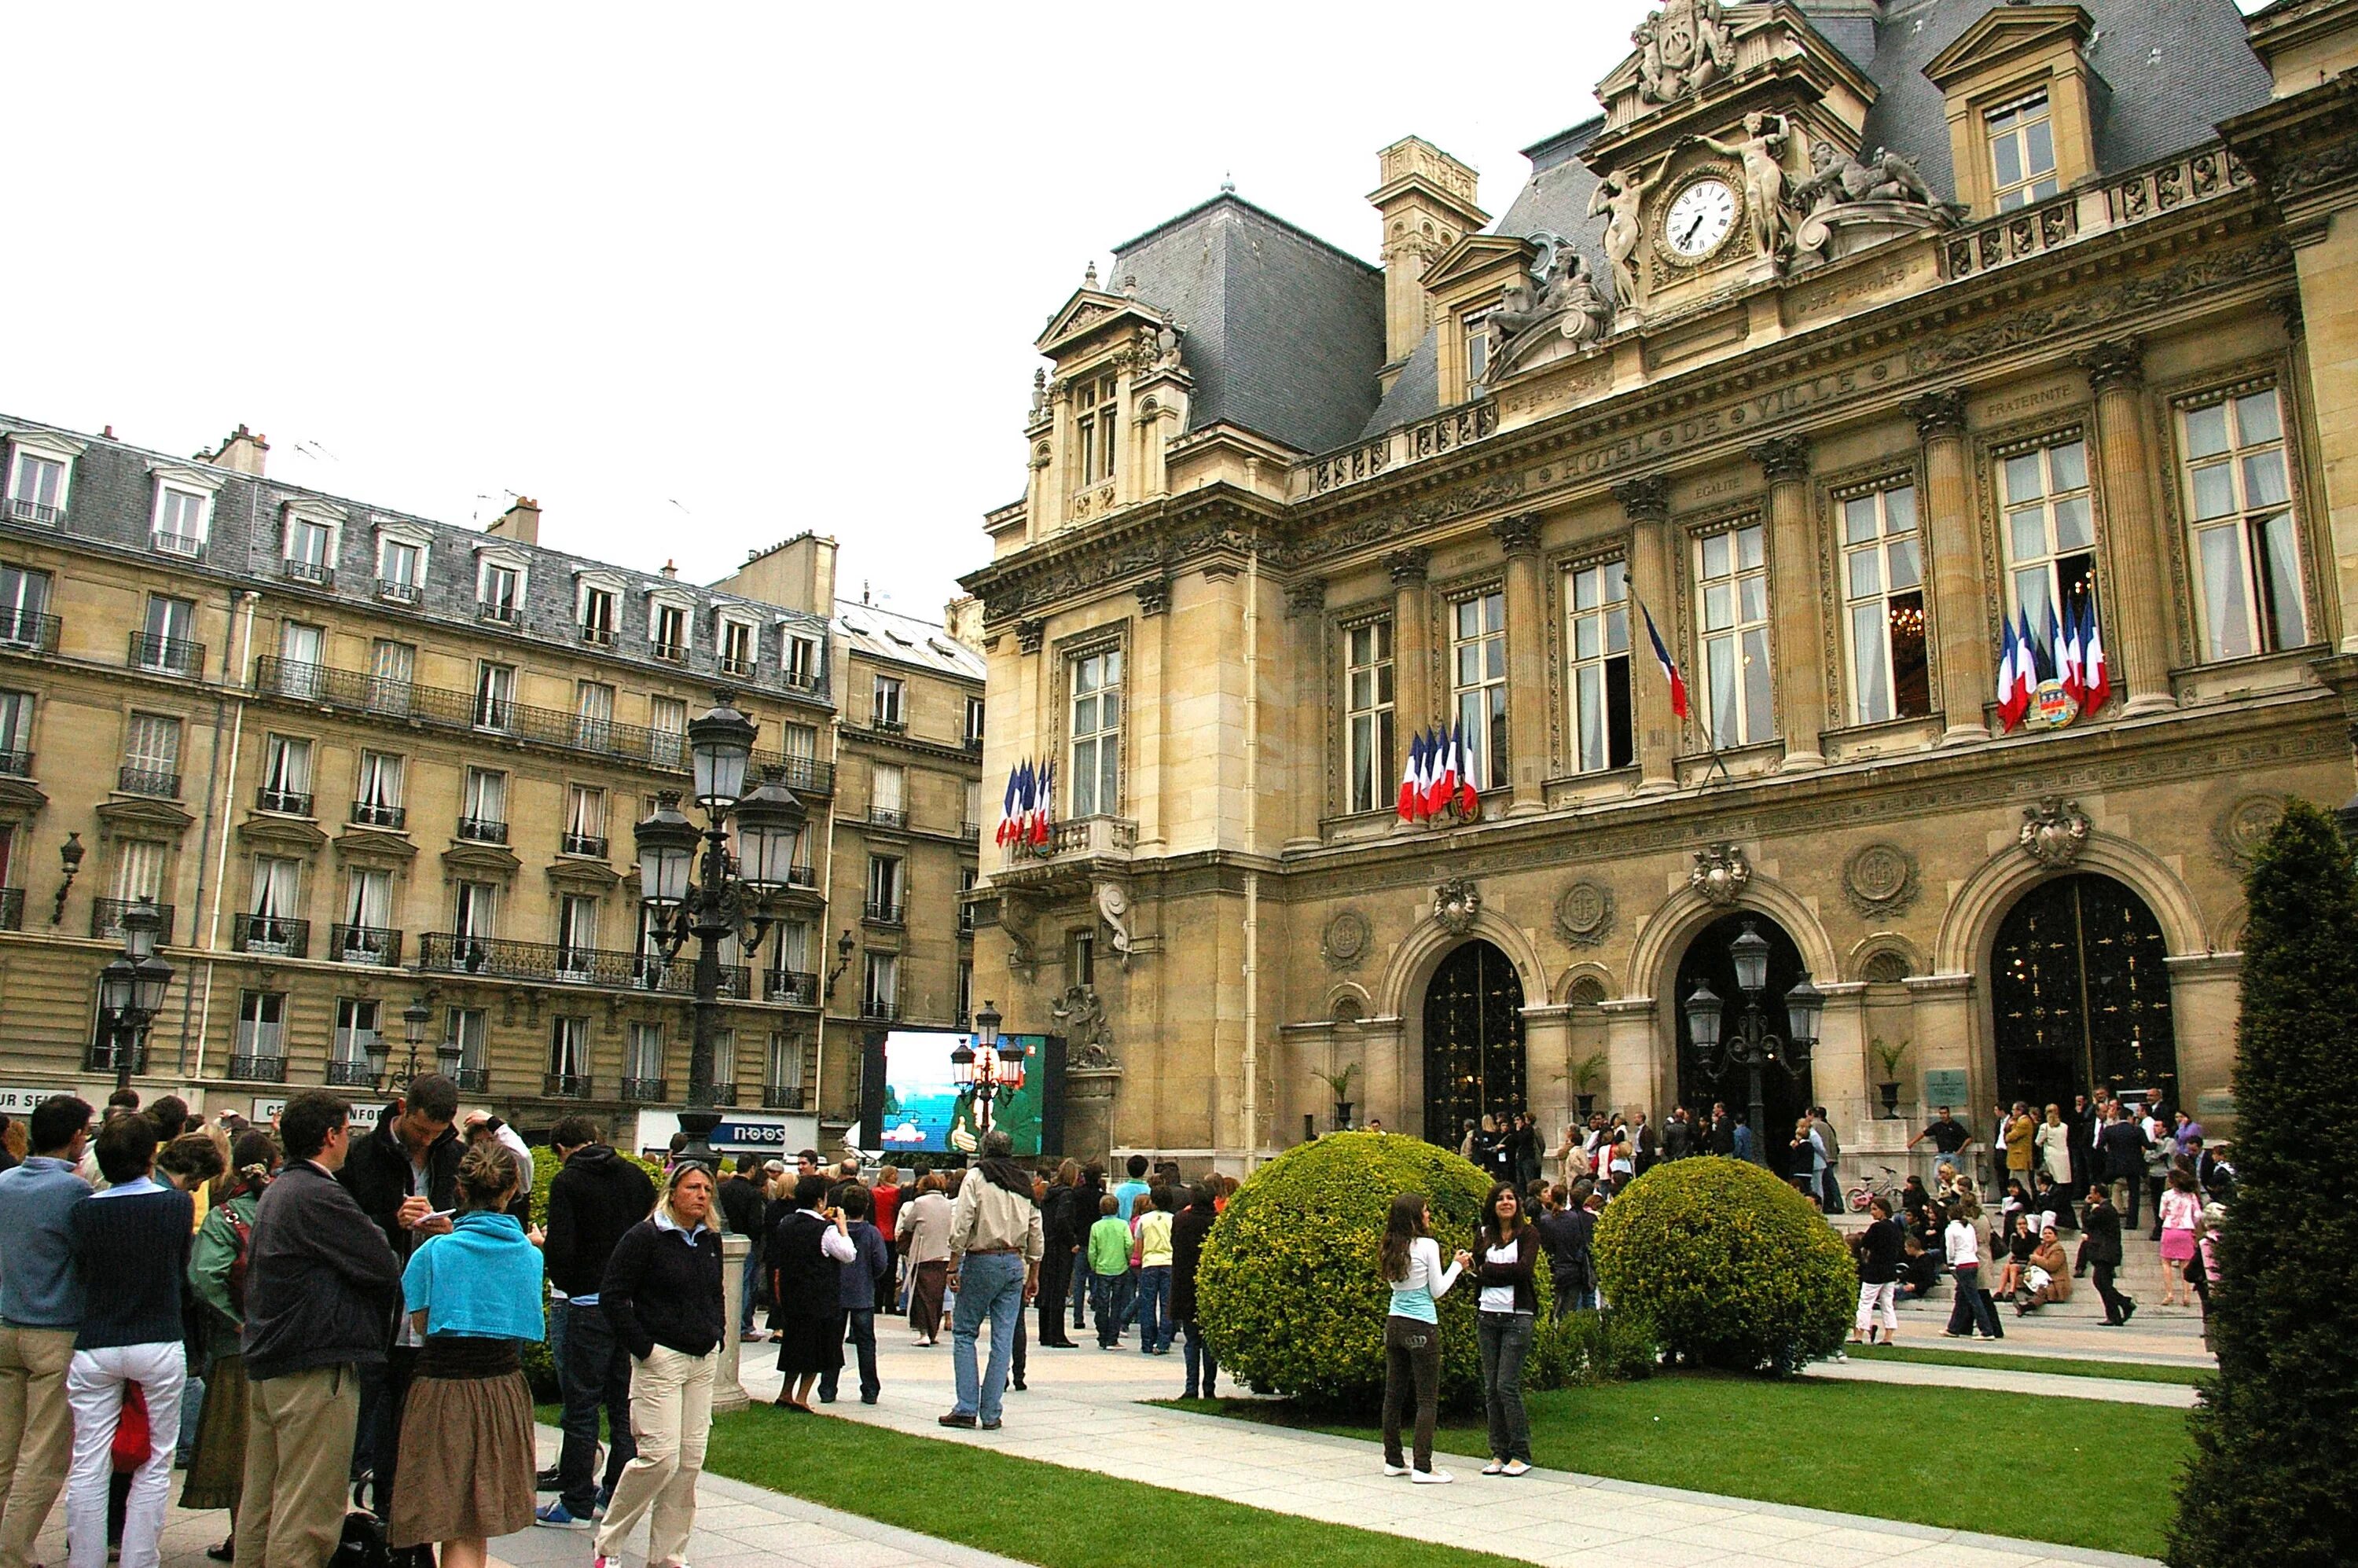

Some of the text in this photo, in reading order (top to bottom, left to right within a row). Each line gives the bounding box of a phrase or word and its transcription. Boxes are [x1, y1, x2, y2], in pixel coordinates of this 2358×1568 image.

[1563, 373, 1856, 479] HOTEL DE VILLE
[734, 1126, 785, 1142] noos
